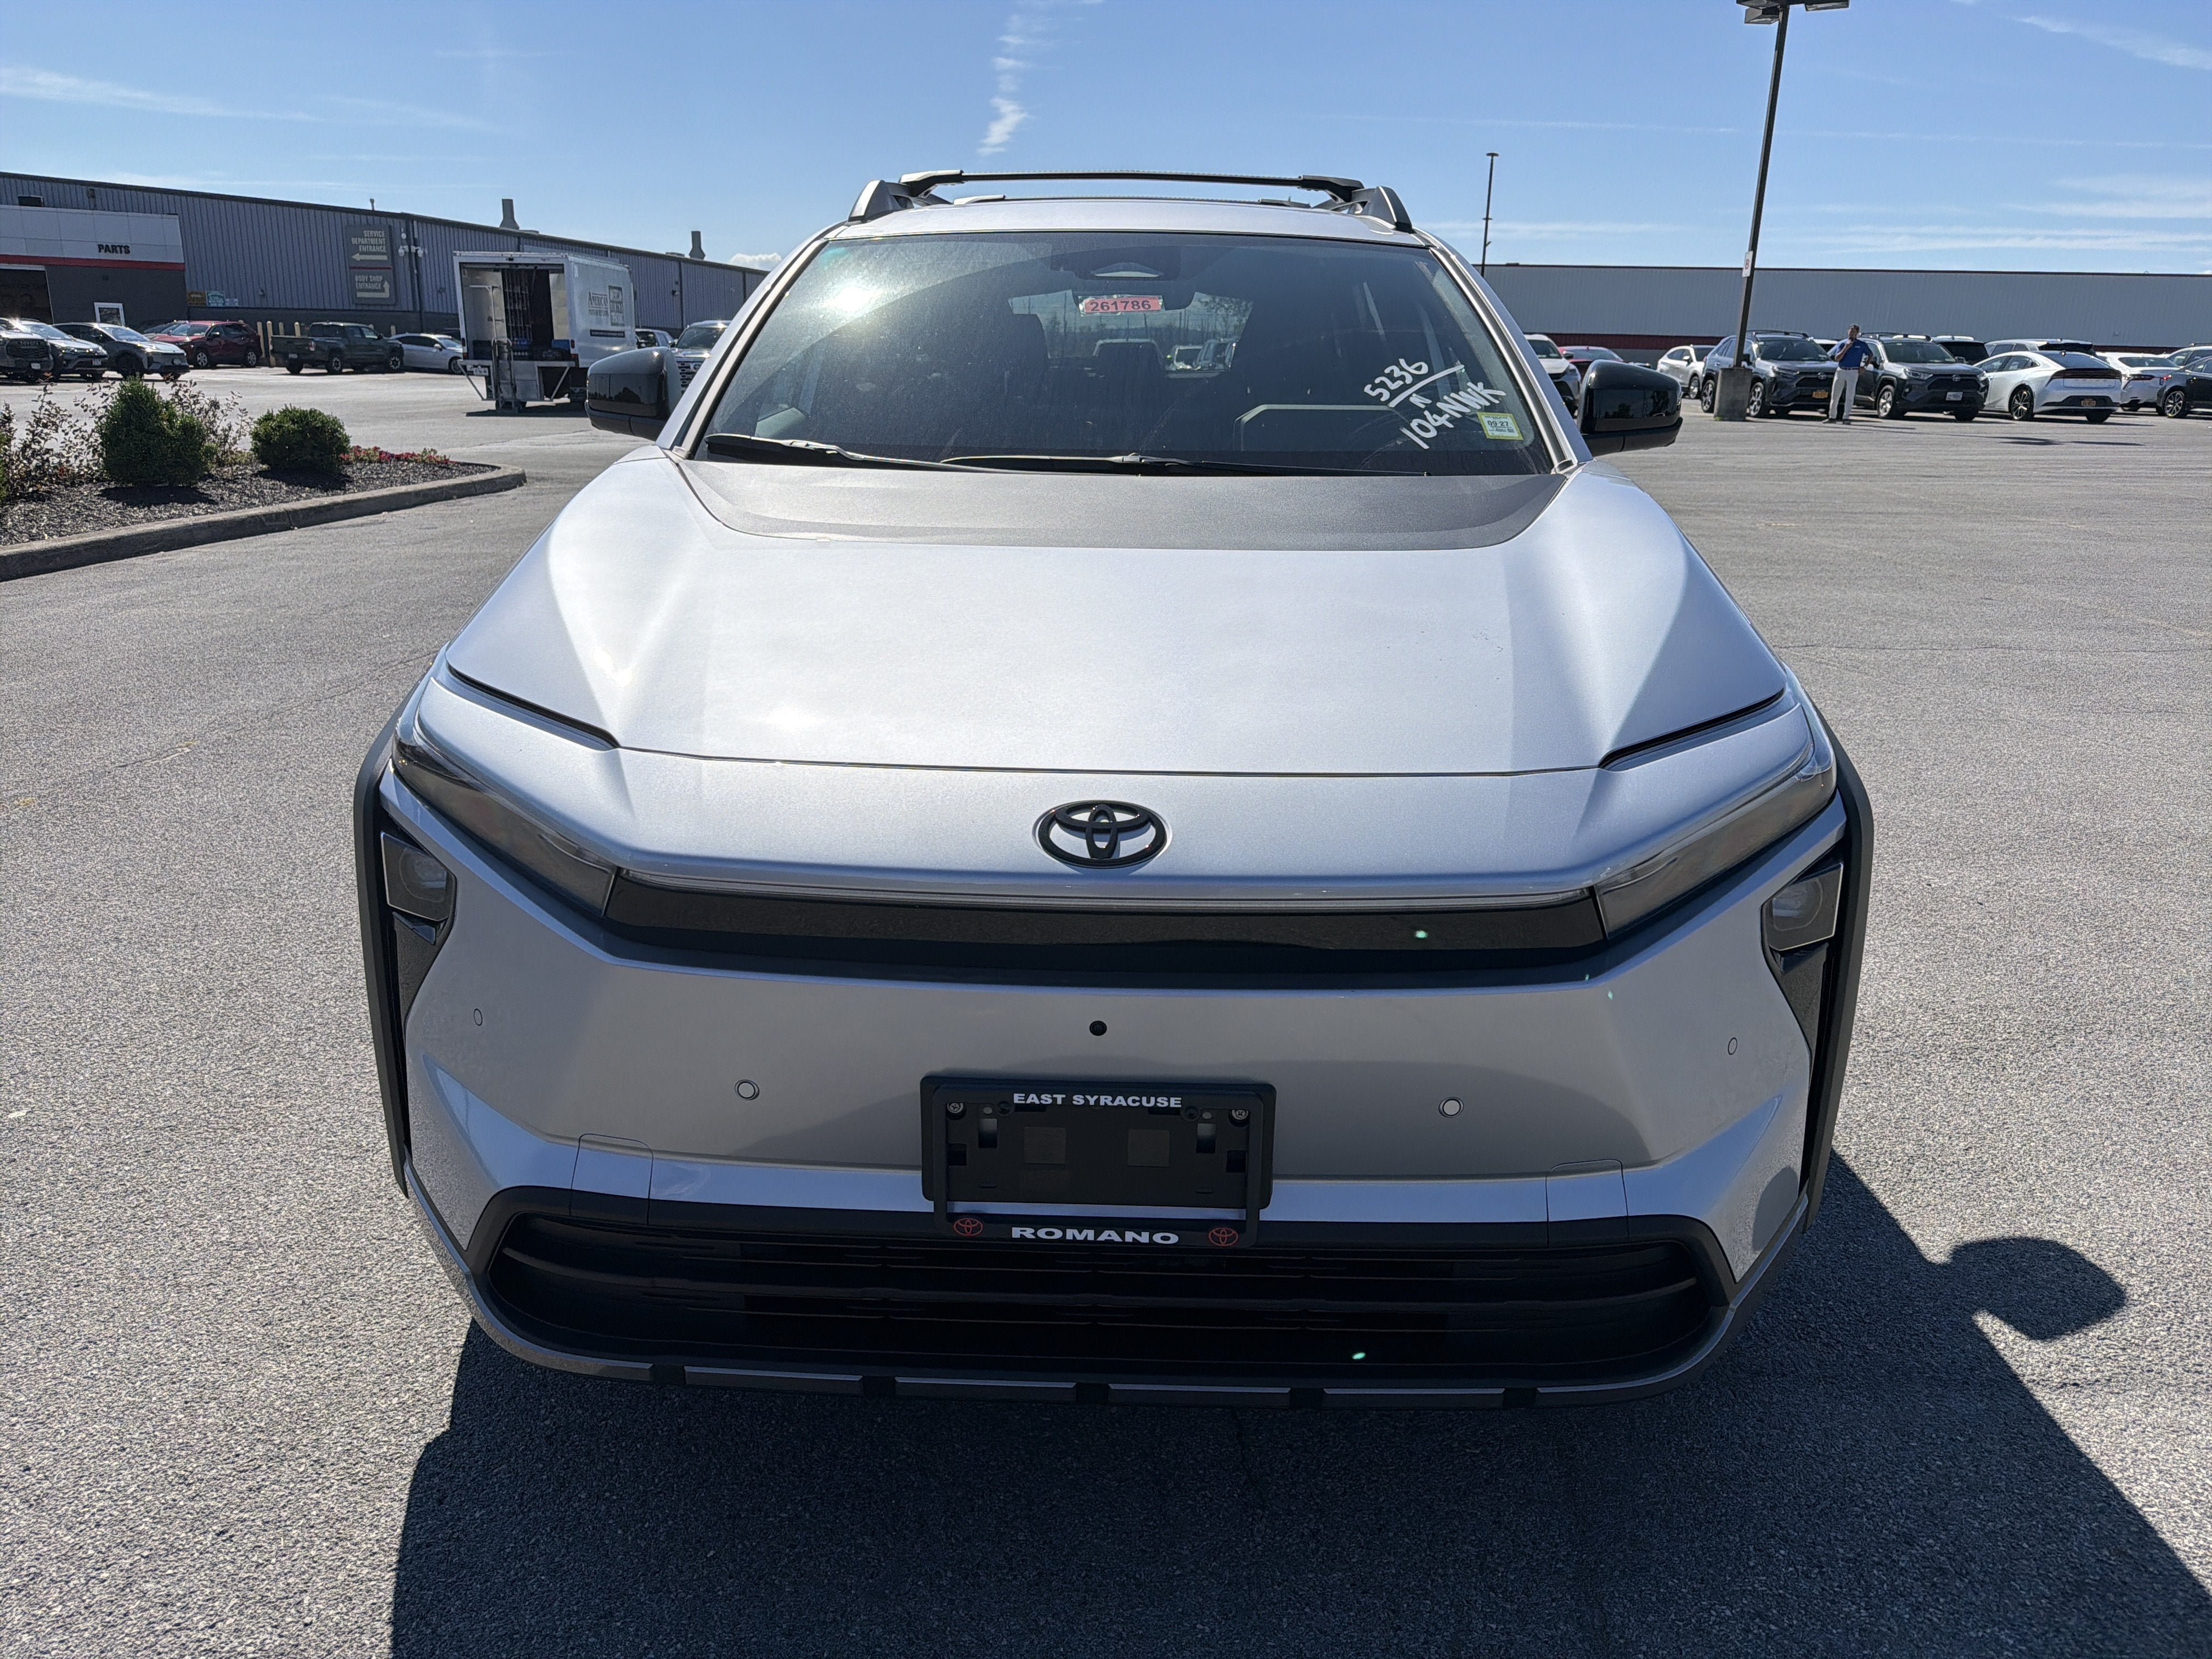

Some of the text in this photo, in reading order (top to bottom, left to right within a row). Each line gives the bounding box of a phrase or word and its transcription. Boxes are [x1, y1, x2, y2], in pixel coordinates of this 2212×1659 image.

[98, 244, 131, 254] PARTS
[1090, 300, 1152, 312] 261786
[1364, 358, 1429, 402] 5236
[1400, 382, 1506, 449] 104NWK
[1013, 1093, 1182, 1108] EAST SYRACUSE
[1012, 1227, 1179, 1244] ROMANO
